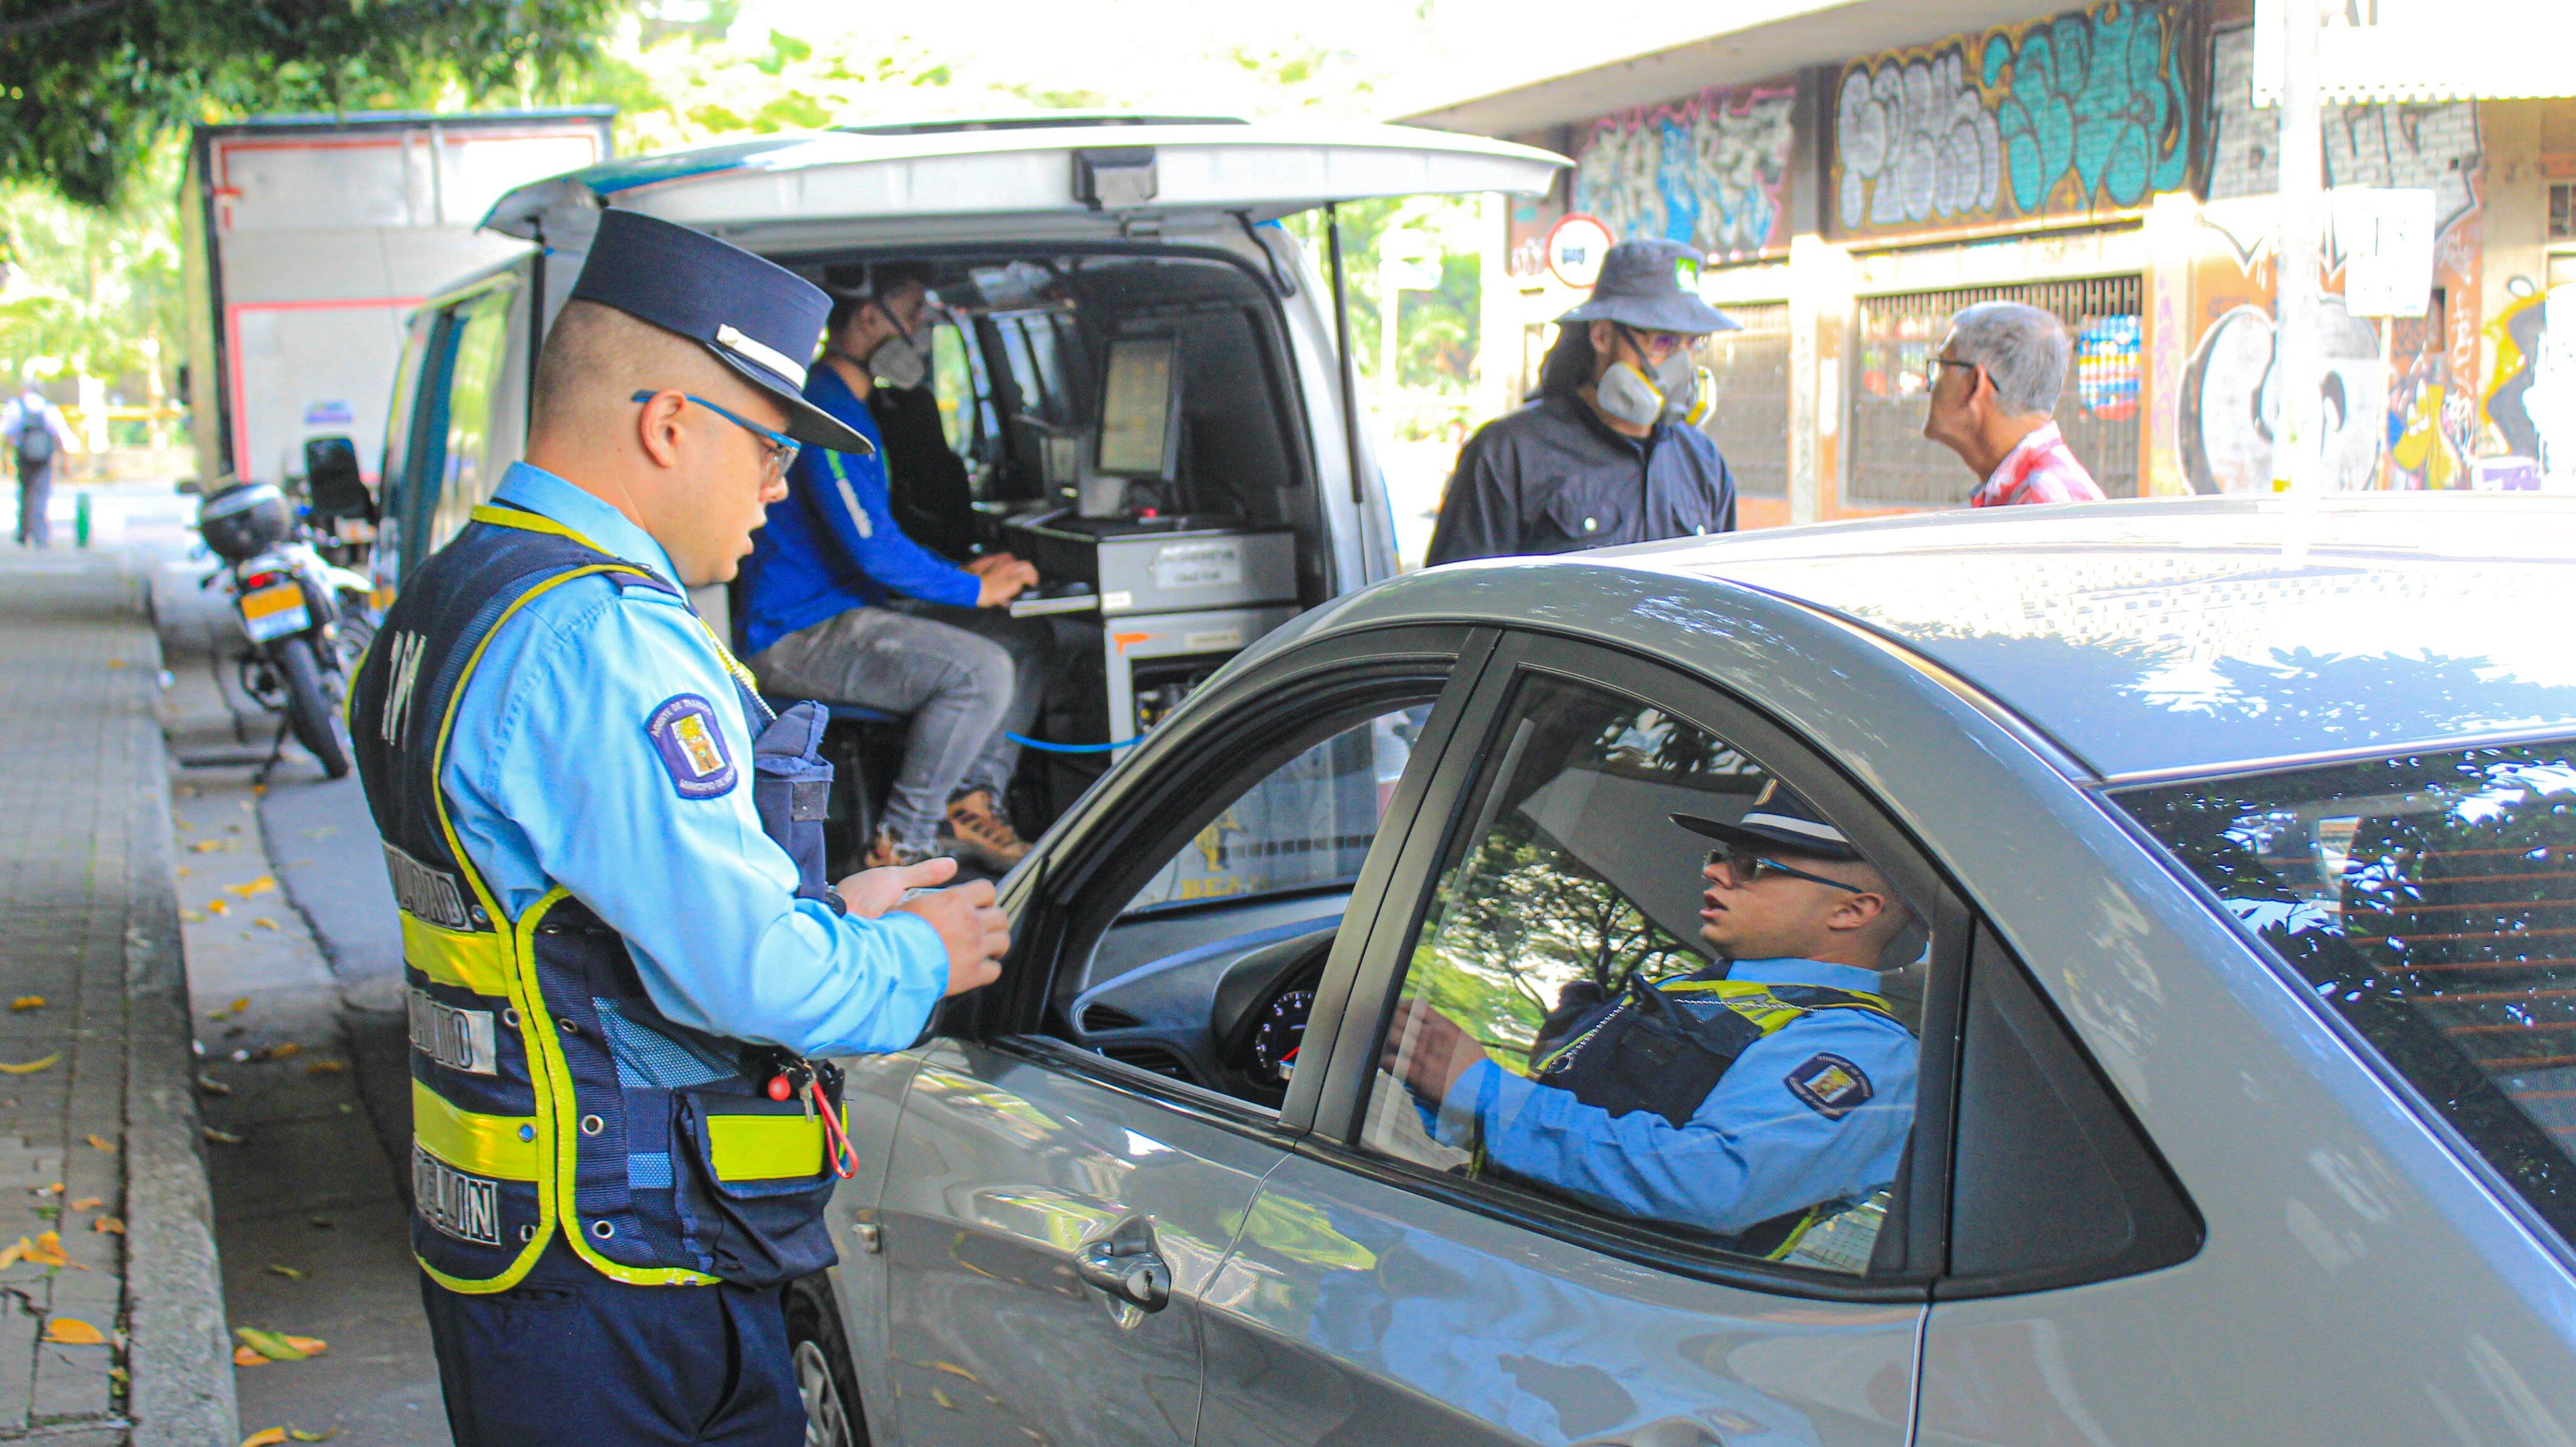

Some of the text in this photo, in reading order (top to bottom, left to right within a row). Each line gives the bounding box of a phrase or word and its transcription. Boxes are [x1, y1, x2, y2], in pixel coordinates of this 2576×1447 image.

[1294, 1000, 1302, 1009] 4
[1275, 1007, 1284, 1016] 3
[1262, 1023, 1271, 1032] 2
